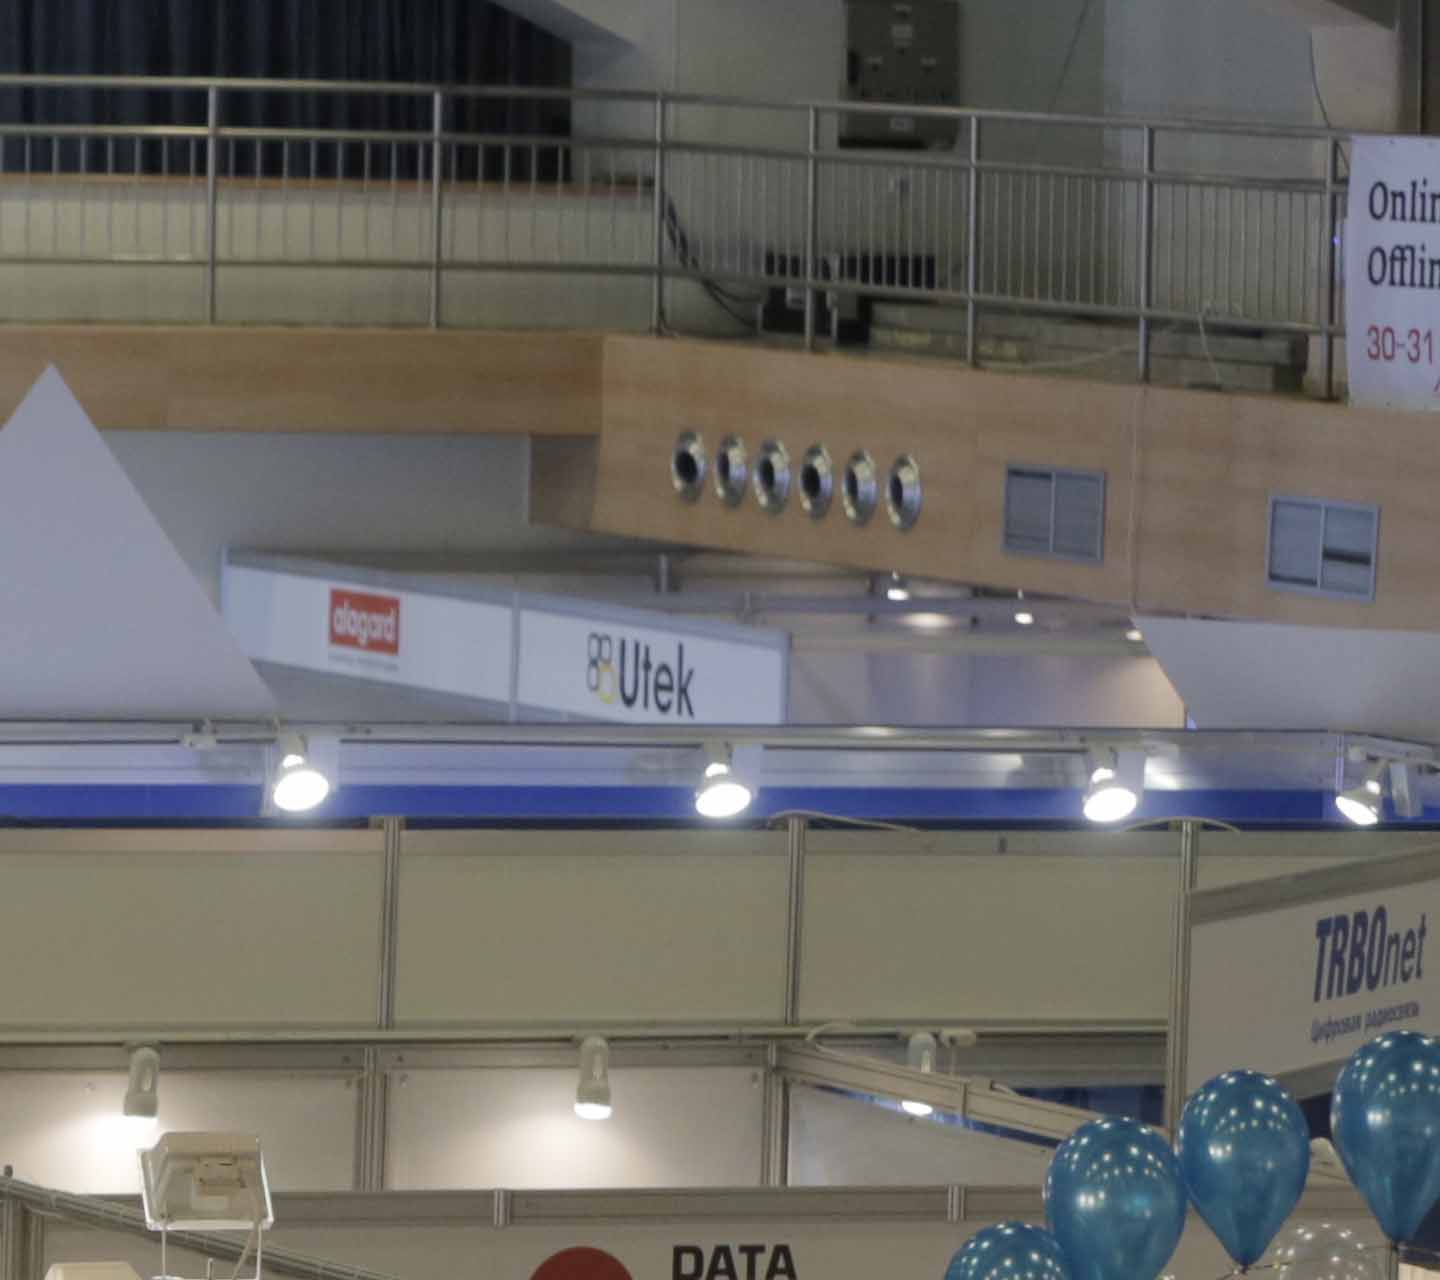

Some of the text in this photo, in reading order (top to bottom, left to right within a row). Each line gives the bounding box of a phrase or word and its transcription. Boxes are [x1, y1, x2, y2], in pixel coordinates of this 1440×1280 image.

[1367, 325, 1434, 365] 30-31
[619, 637, 696, 718] Utek
[1313, 905, 1427, 1003] TRBOnet
